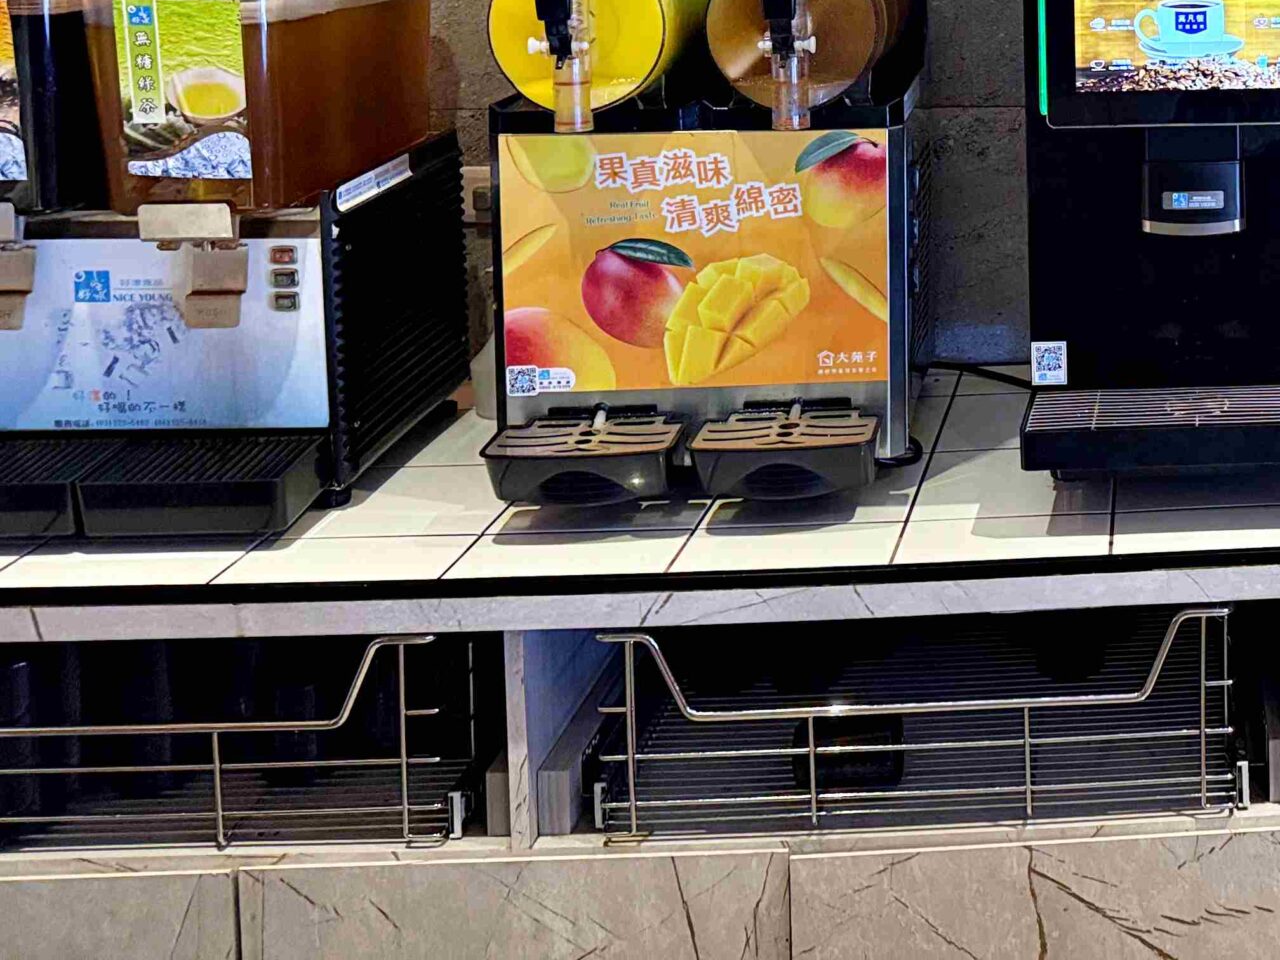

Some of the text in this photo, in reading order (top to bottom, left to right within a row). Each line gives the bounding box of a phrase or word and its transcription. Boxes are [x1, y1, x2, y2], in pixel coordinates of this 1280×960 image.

[135, 31, 157, 114] 無糖綠茶
[598, 152, 729, 190] 果真滋味
[666, 184, 799, 233] 清爽綿密
[113, 293, 173, 303] NICE YOUNG
[835, 351, 877, 363] 大苑子
